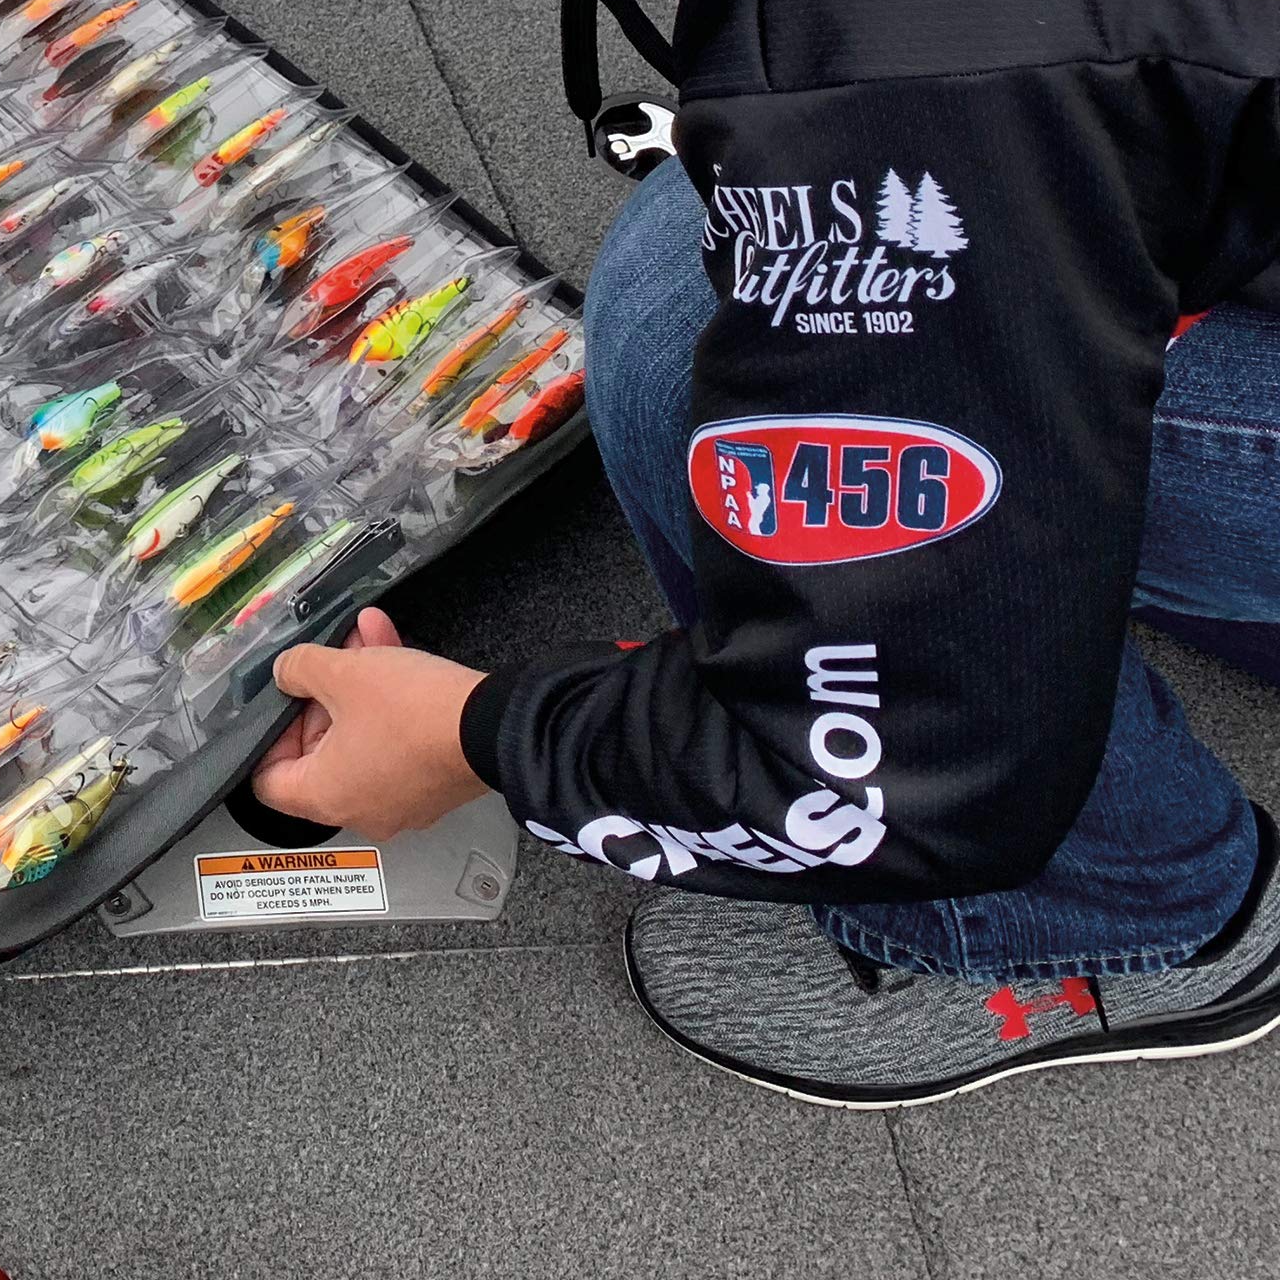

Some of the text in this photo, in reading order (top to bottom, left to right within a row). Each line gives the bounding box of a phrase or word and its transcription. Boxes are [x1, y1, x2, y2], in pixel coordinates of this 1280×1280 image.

[795, 311, 915, 334] SINCE 1902
[781, 441, 951, 532] 456
[257, 853, 338, 870] WARNING
[214, 874, 368, 889] AVOID SERIOUS OR FATAL INJURY.
[210, 885, 375, 901] DO NOT OCCUPY SEAT WHEN SPEED
[256, 898, 333, 910] EXCEEDS 5 MPH.
